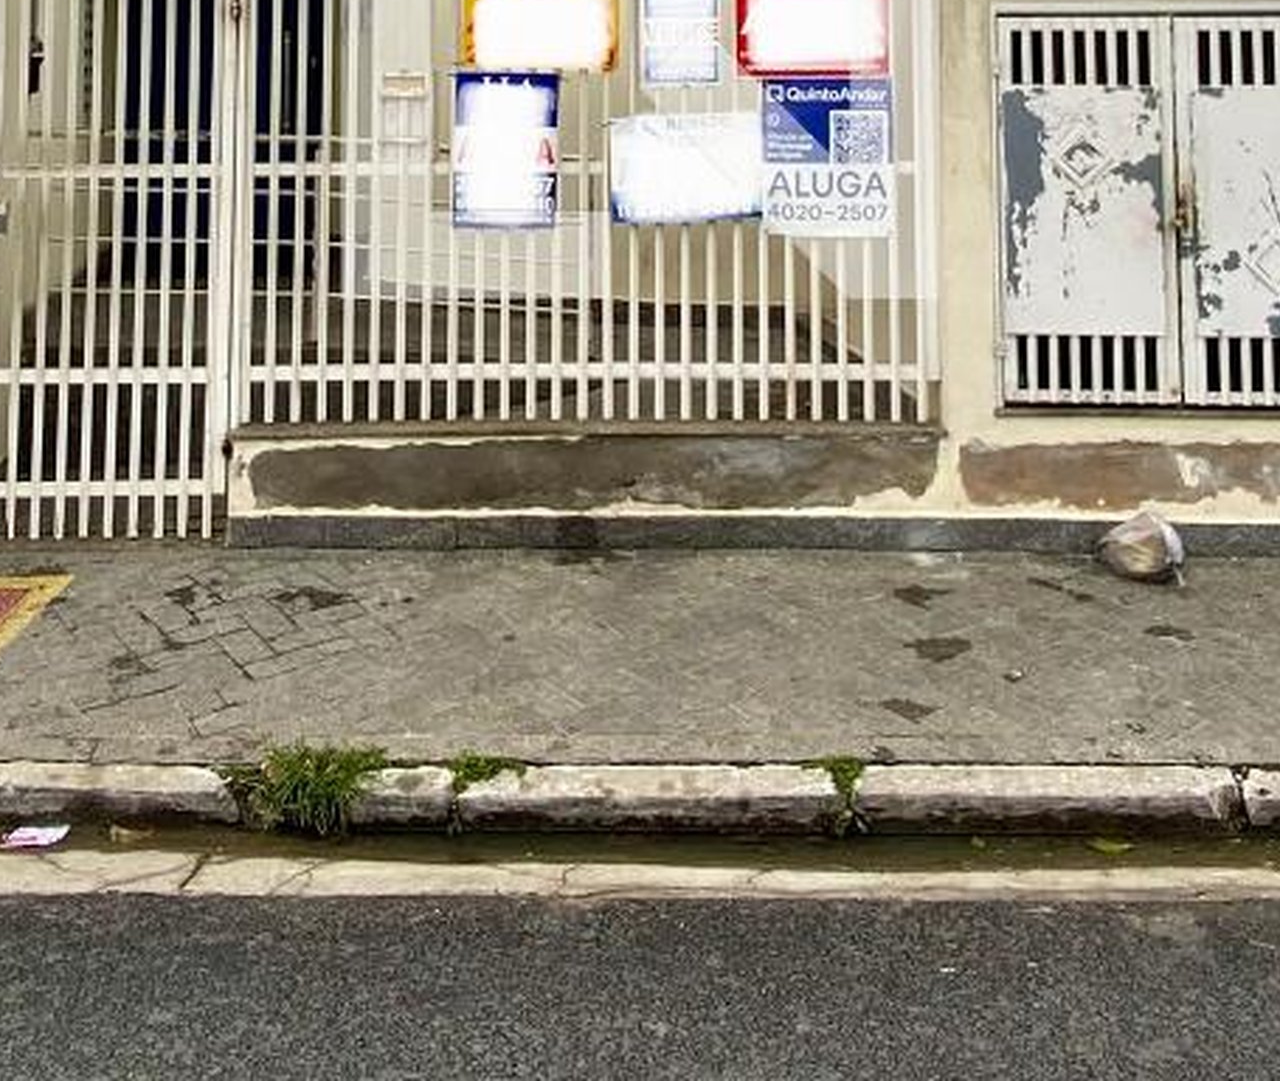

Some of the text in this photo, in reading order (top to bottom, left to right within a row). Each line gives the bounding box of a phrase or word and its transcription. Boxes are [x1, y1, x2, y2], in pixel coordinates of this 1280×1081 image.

[785, 85, 888, 104] QuintoAndar
[768, 170, 888, 199] ALUGA
[768, 203, 888, 221] 4020-2507
